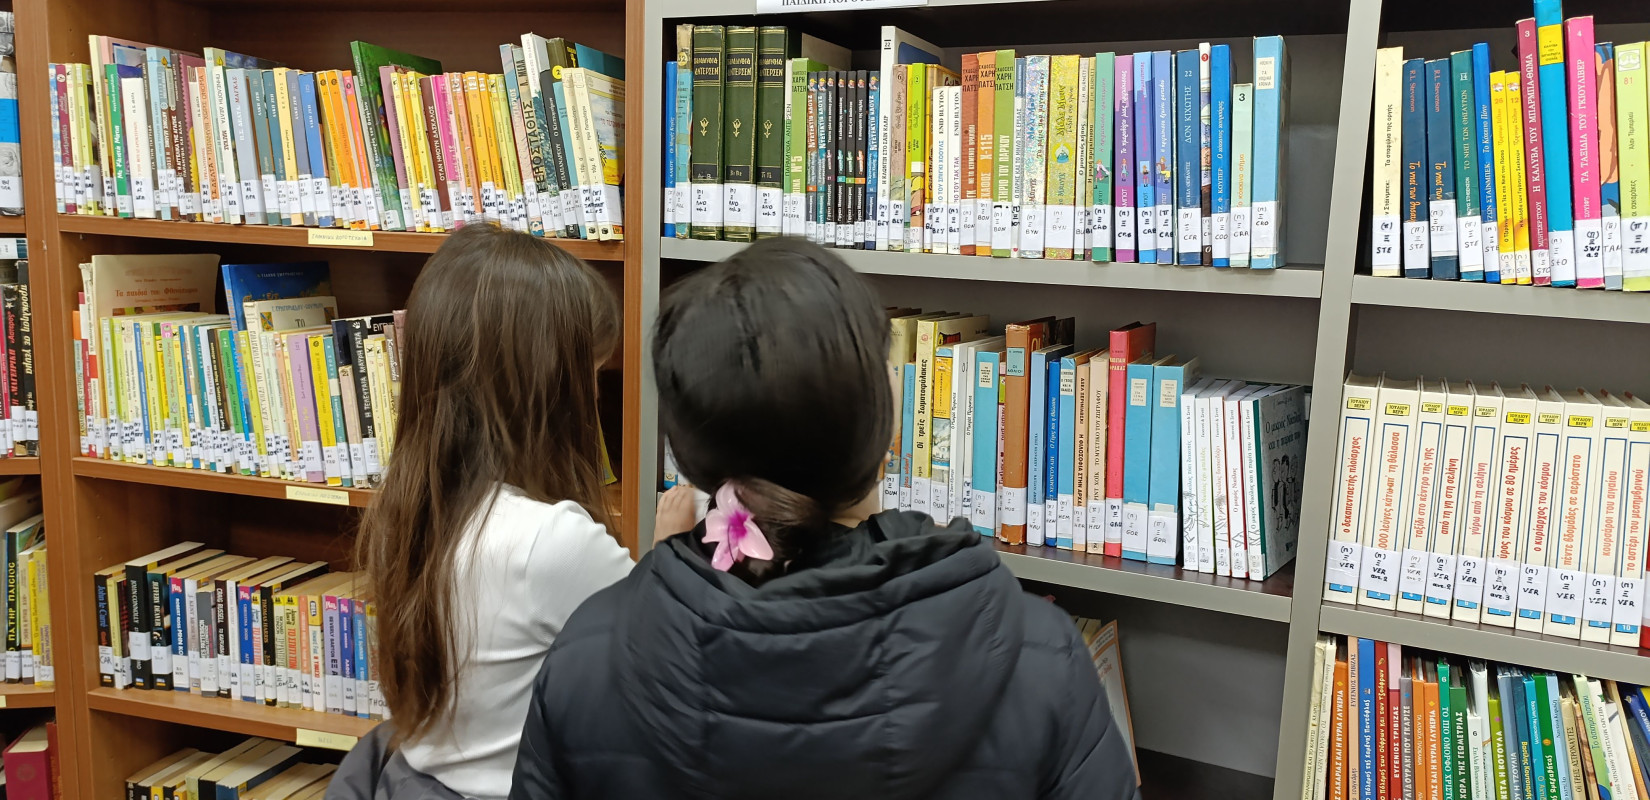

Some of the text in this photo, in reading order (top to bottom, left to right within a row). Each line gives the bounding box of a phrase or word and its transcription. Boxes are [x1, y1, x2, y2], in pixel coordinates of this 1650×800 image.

[1577, 59, 1586, 110] ΓΚΙΟΥΛΙΒΕΡ
[1184, 85, 1192, 143] ΔΟΝ ΚΙΧΩΤΗΣ
[1579, 113, 1587, 131] ΤΟΥ
[1529, 127, 1538, 143] ΤΟΥ
[1579, 133, 1588, 168] ΤΑΞΙΔΙΑ
[1531, 147, 1540, 182] ΚΑΛΥΒΑ
[1581, 170, 1589, 183] ΤΑ
[1347, 436, 1361, 473] πλοίαρχος
[1386, 432, 1400, 463] θάλασσα
[1506, 446, 1520, 474] ημέρες
[1387, 464, 1396, 473] τη
[1505, 474, 1515, 486] 80
[1538, 462, 1551, 490] κόσμου
[1568, 454, 1582, 495] αερόστατο
[1341, 474, 1357, 527] δεκαπενταετής
[1413, 447, 1434, 538] ταξίδι στο κέντρο της γης
[1438, 458, 1459, 535] από τη γη στη σελήνη
[1469, 462, 1487, 536] γύρω από τη σελήνη
[1506, 487, 1515, 496] σε
[1569, 496, 1577, 506] σε
[1380, 508, 1392, 532] λεύγες
[1501, 498, 1514, 525] κόσμου
[1533, 506, 1548, 545] κυρίαρχος
[1601, 471, 1617, 556] κουρσάροι του αιγαίου
[1625, 469, 1644, 572] το αστέρι του μεσημβρινού
[1501, 526, 1510, 539] του
[1562, 544, 1573, 566] πέντε
[1442, 706, 1451, 772] ΤΟ ΠΙΟ ΟΜΟΡΦΟ
